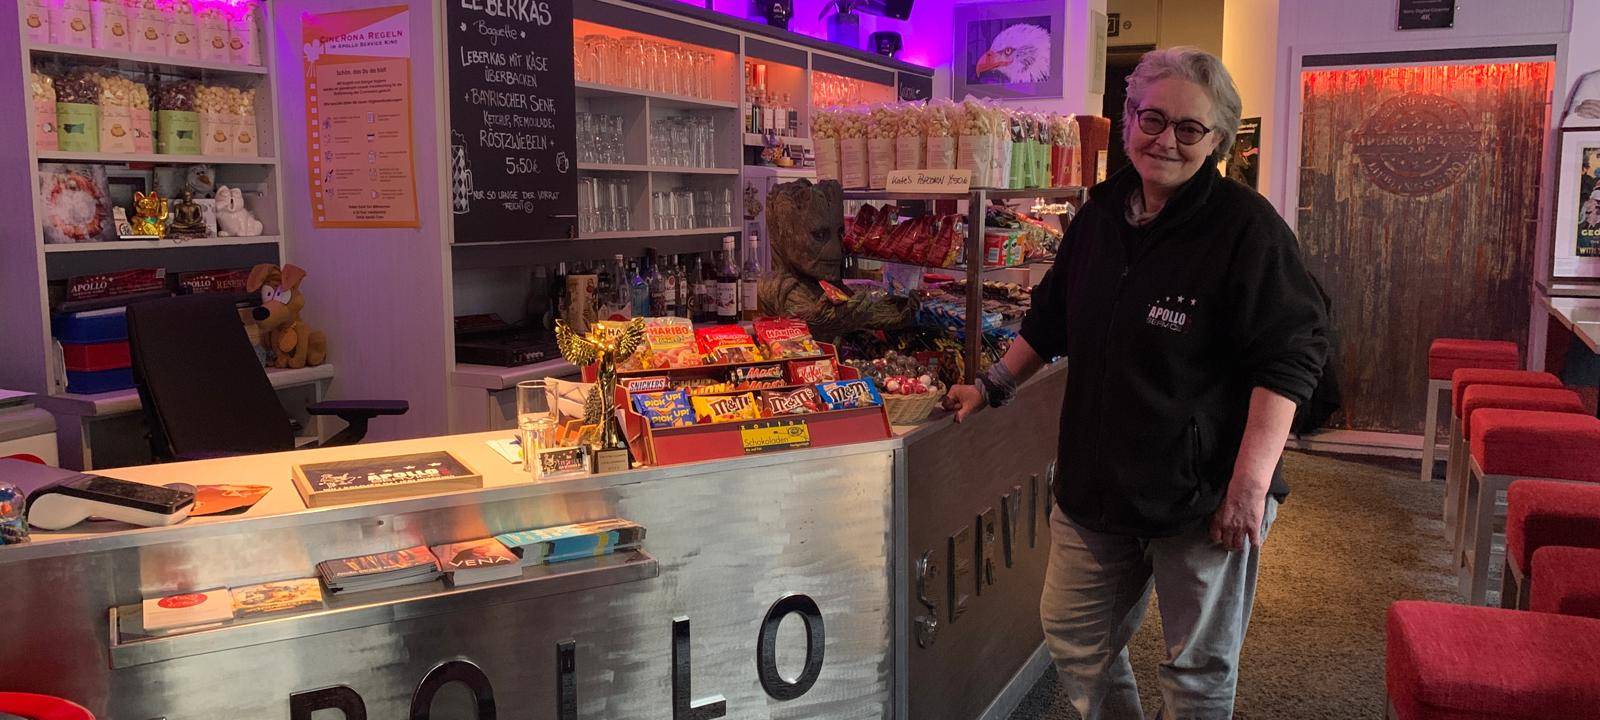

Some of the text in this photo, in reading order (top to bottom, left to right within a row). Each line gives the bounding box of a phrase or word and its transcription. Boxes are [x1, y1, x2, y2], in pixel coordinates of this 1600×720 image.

[473, 19, 517, 46] Baguette
[460, 46, 506, 66] LEBERKAS
[485, 65, 537, 87] ÜBERBACKEN
[471, 88, 527, 109] BAYRISCHER
[480, 128, 547, 150] RÖSTZWIEBELN
[71, 281, 108, 294] APOLLO
[1148, 305, 1187, 326] APOLLO
[650, 326, 689, 336] HARIBO
[765, 328, 802, 338] HARIBO
[629, 380, 665, 391] SNICKERS
[644, 392, 682, 407] PICK UP!
[651, 409, 690, 423] PICK UP!
[744, 435, 789, 447] Schokoladen
[367, 468, 440, 482] APOLLO
[449, 556, 511, 567] VENA
